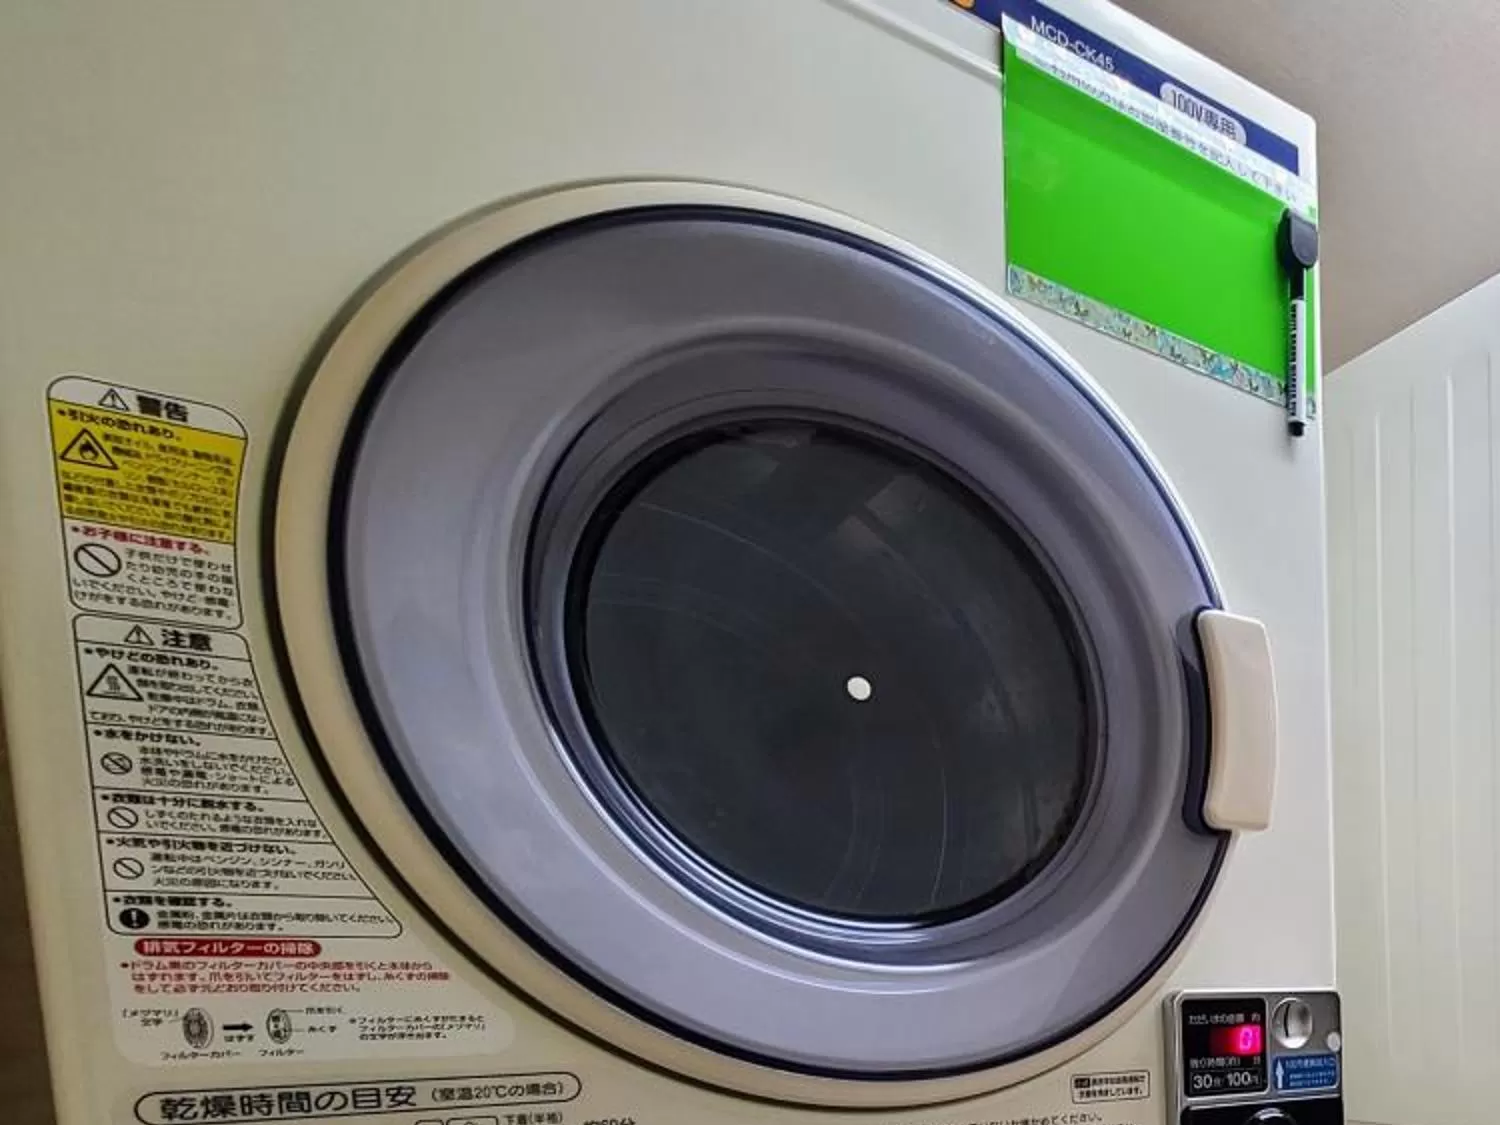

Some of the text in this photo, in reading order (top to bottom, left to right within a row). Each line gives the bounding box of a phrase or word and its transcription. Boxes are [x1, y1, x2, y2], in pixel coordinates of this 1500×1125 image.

[1031, 15, 1115, 72] MCD-CK45
[161, 628, 212, 651] 注意
[160, 1085, 418, 1121] 乾燥時間の目安
